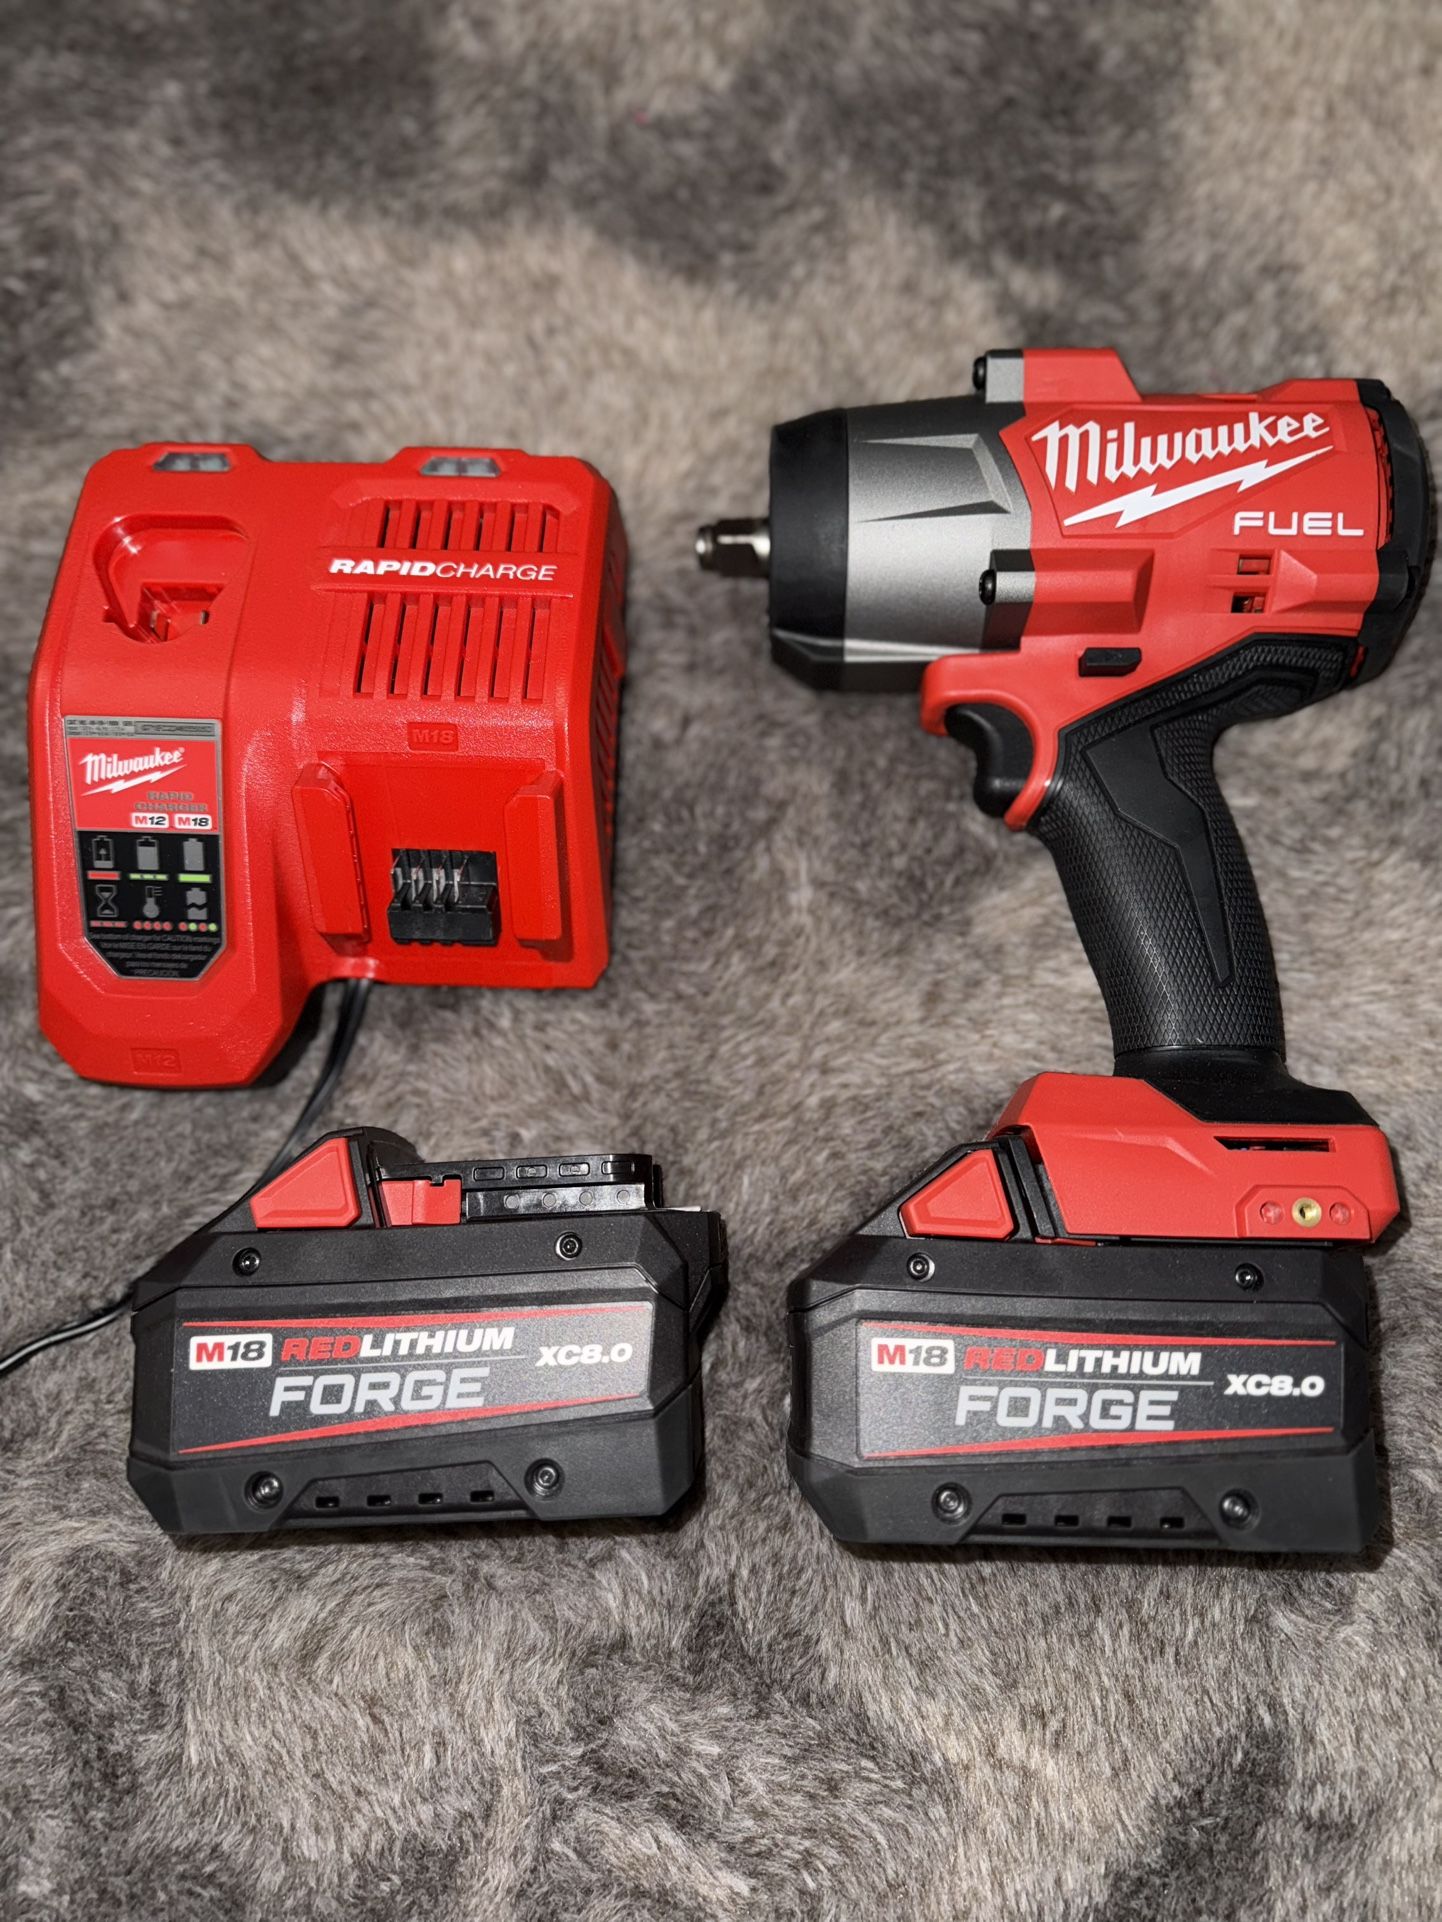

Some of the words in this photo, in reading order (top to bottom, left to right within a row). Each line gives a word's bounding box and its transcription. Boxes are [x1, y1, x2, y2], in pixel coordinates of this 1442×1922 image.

[1031, 411, 1332, 494] Milwaukee
[1233, 511, 1364, 537] FUEL
[328, 558, 558, 582] RAPIDCHARGE
[412, 728, 455, 745] M18
[79, 747, 184, 785] Milwaukee
[134, 802, 207, 813] CHARGER
[147, 791, 193, 802] RAPID
[135, 815, 166, 826] M12
[178, 817, 210, 827] M18
[195, 1341, 267, 1364] M18
[281, 1327, 515, 1361] REDLITHIUM
[534, 1342, 634, 1367] XC8.0
[877, 1344, 949, 1368] M18
[963, 1346, 1203, 1377] REDLITHIUM
[1223, 1373, 1326, 1398] XC8.0
[269, 1367, 491, 1417] FORGE
[954, 1385, 1180, 1431] FORGE
